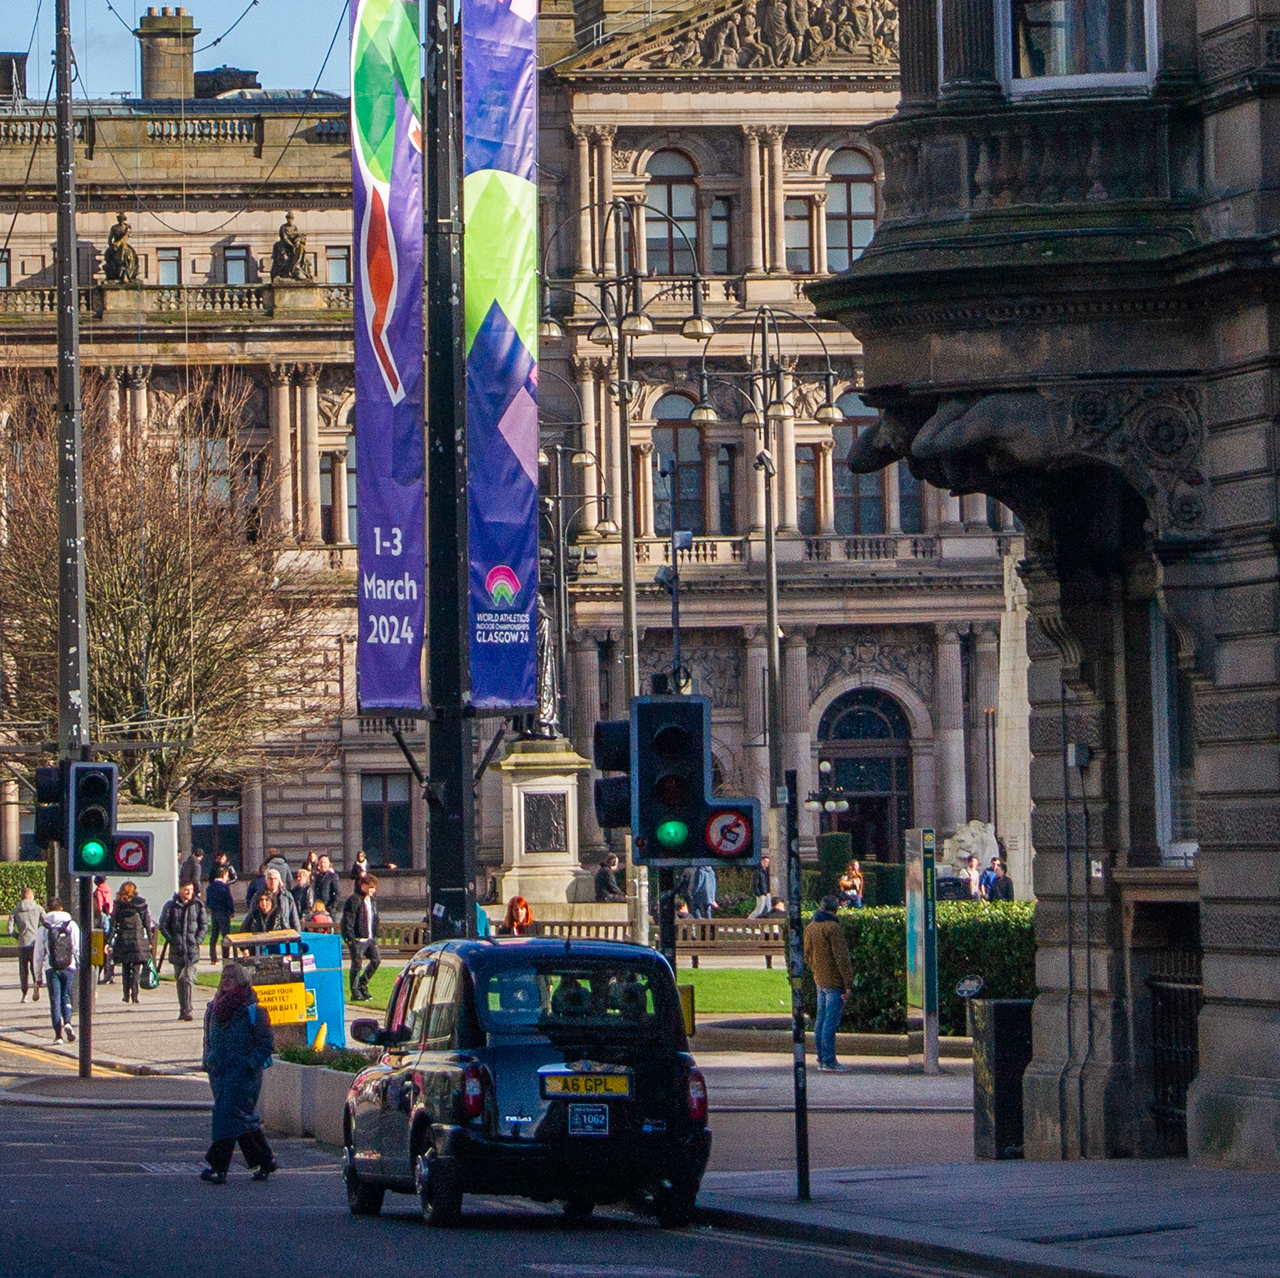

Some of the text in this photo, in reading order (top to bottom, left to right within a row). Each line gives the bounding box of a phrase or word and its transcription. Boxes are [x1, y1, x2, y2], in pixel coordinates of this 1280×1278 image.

[373, 526, 403, 556] 1-3
[363, 571, 418, 600] March
[476, 613, 530, 622] WORLD ATHLETICS
[367, 614, 414, 644] 2024
[476, 631, 529, 643] GLASGOW 24
[561, 1077, 613, 1092] A6 GPL
[582, 1114, 605, 1124] 1062
